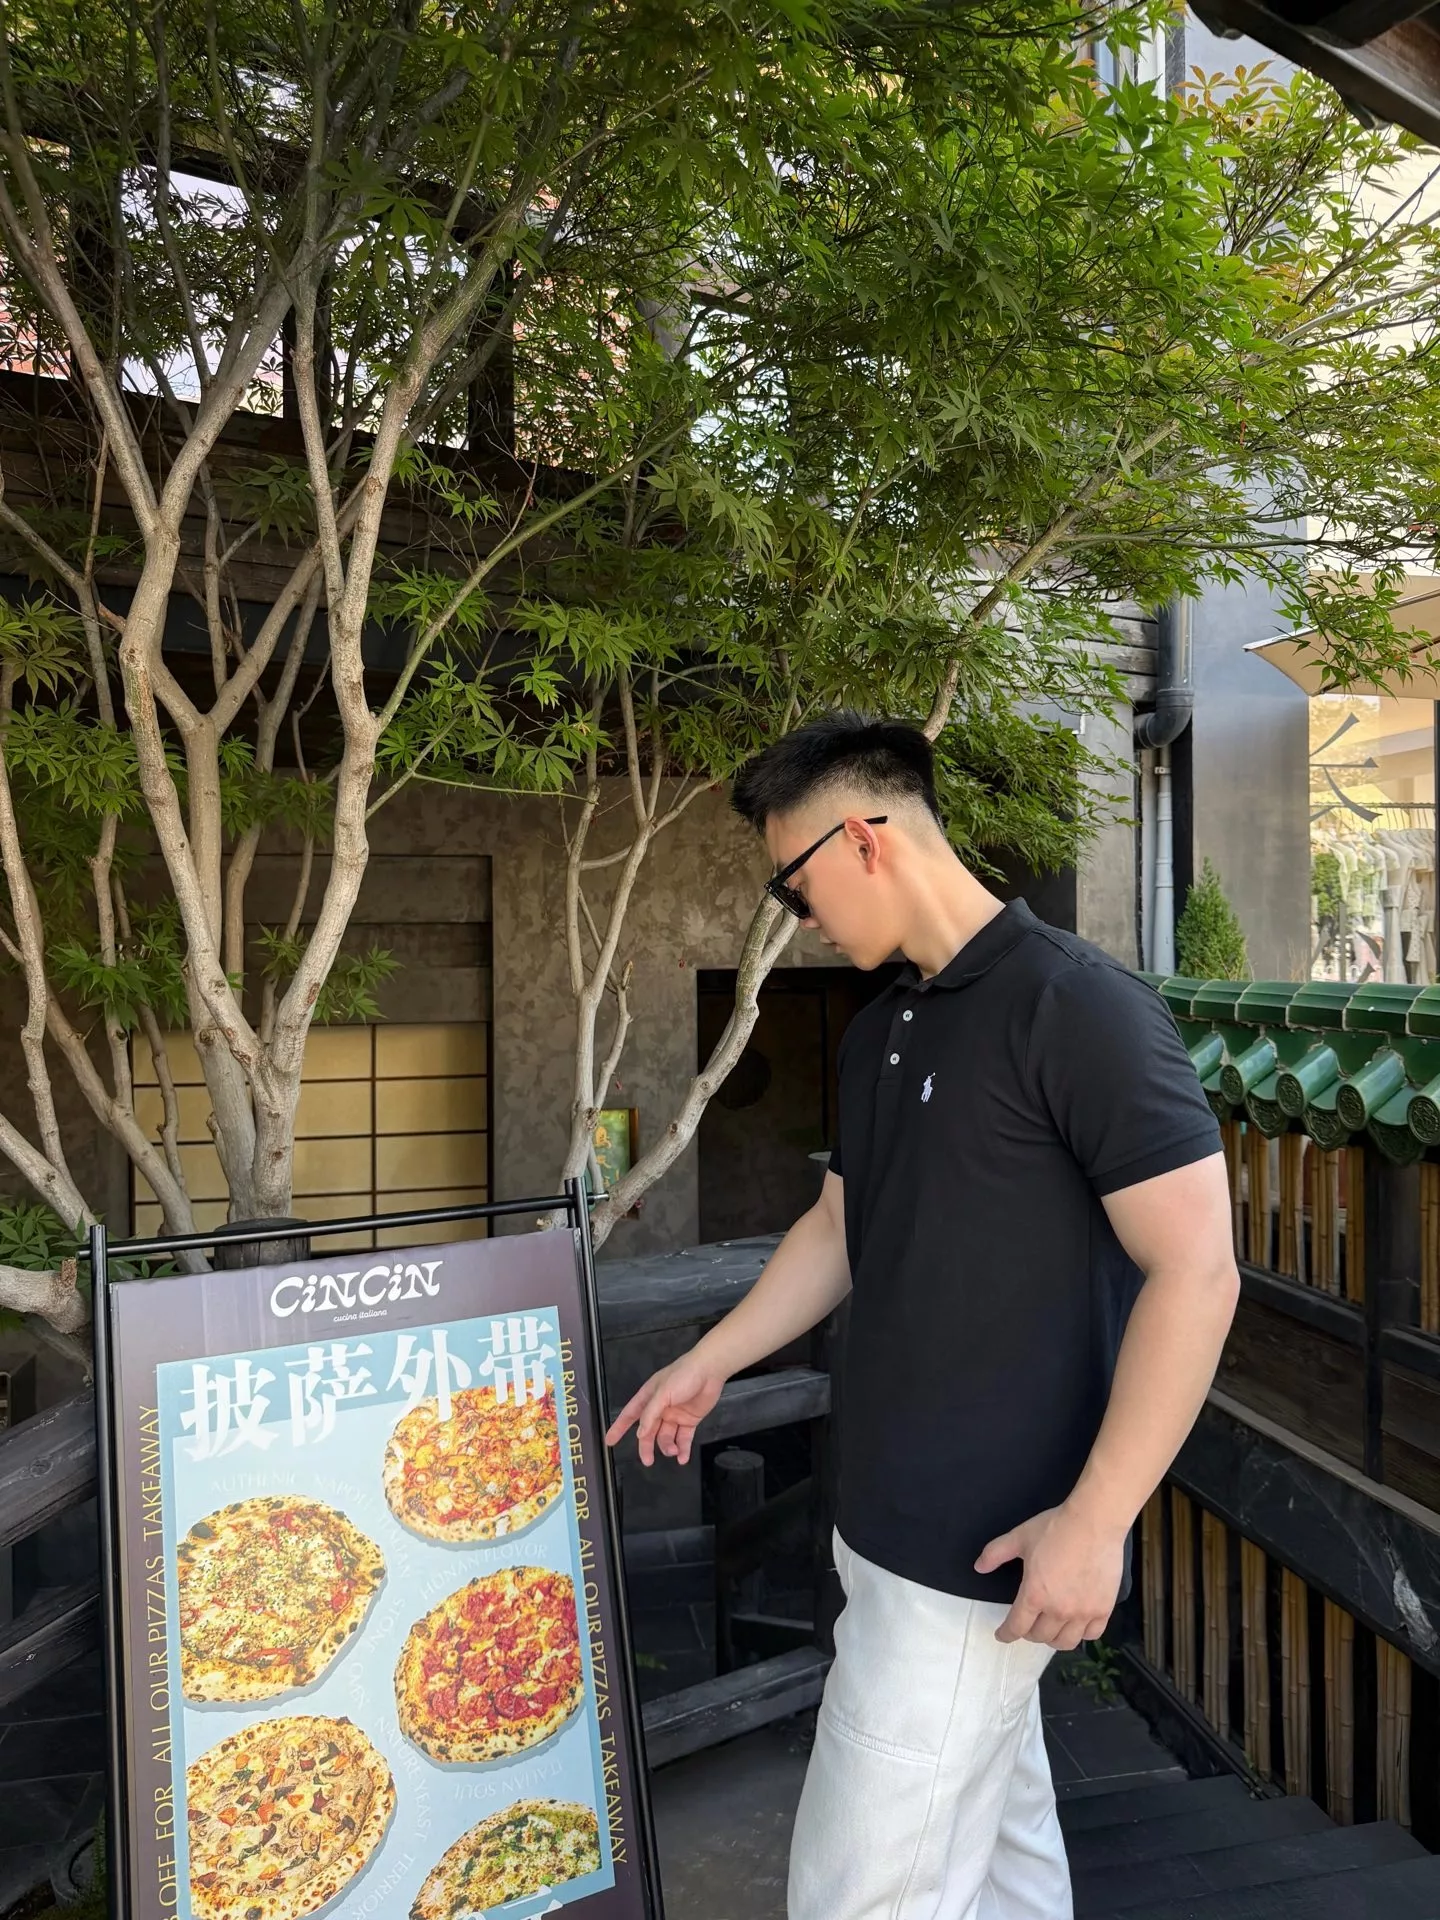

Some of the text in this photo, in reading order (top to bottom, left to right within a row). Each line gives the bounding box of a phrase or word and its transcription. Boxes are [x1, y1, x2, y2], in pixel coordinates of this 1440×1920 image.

[333, 1308, 388, 1323] cucina italiana
[560, 1338, 573, 1362] 10
[180, 1316, 558, 1463] 披萨外带
[562, 1370, 579, 1417] RMB
[567, 1425, 584, 1465] OFF
[139, 1405, 164, 1542] TAKEAWAY
[573, 1476, 590, 1521] FOR
[145, 1555, 168, 1643] PIZZAS
[584, 1583, 602, 1634] OUR
[149, 1647, 171, 1711] OUR
[589, 1642, 612, 1721] PIZZAS
[374, 1716, 432, 1844] NATURE YEAST
[453, 1758, 564, 1803] ITALIAN SOUL
[600, 1731, 627, 1864] TAKEAWAY
[154, 1784, 176, 1841] FOR
[158, 1854, 179, 1907] OFF
